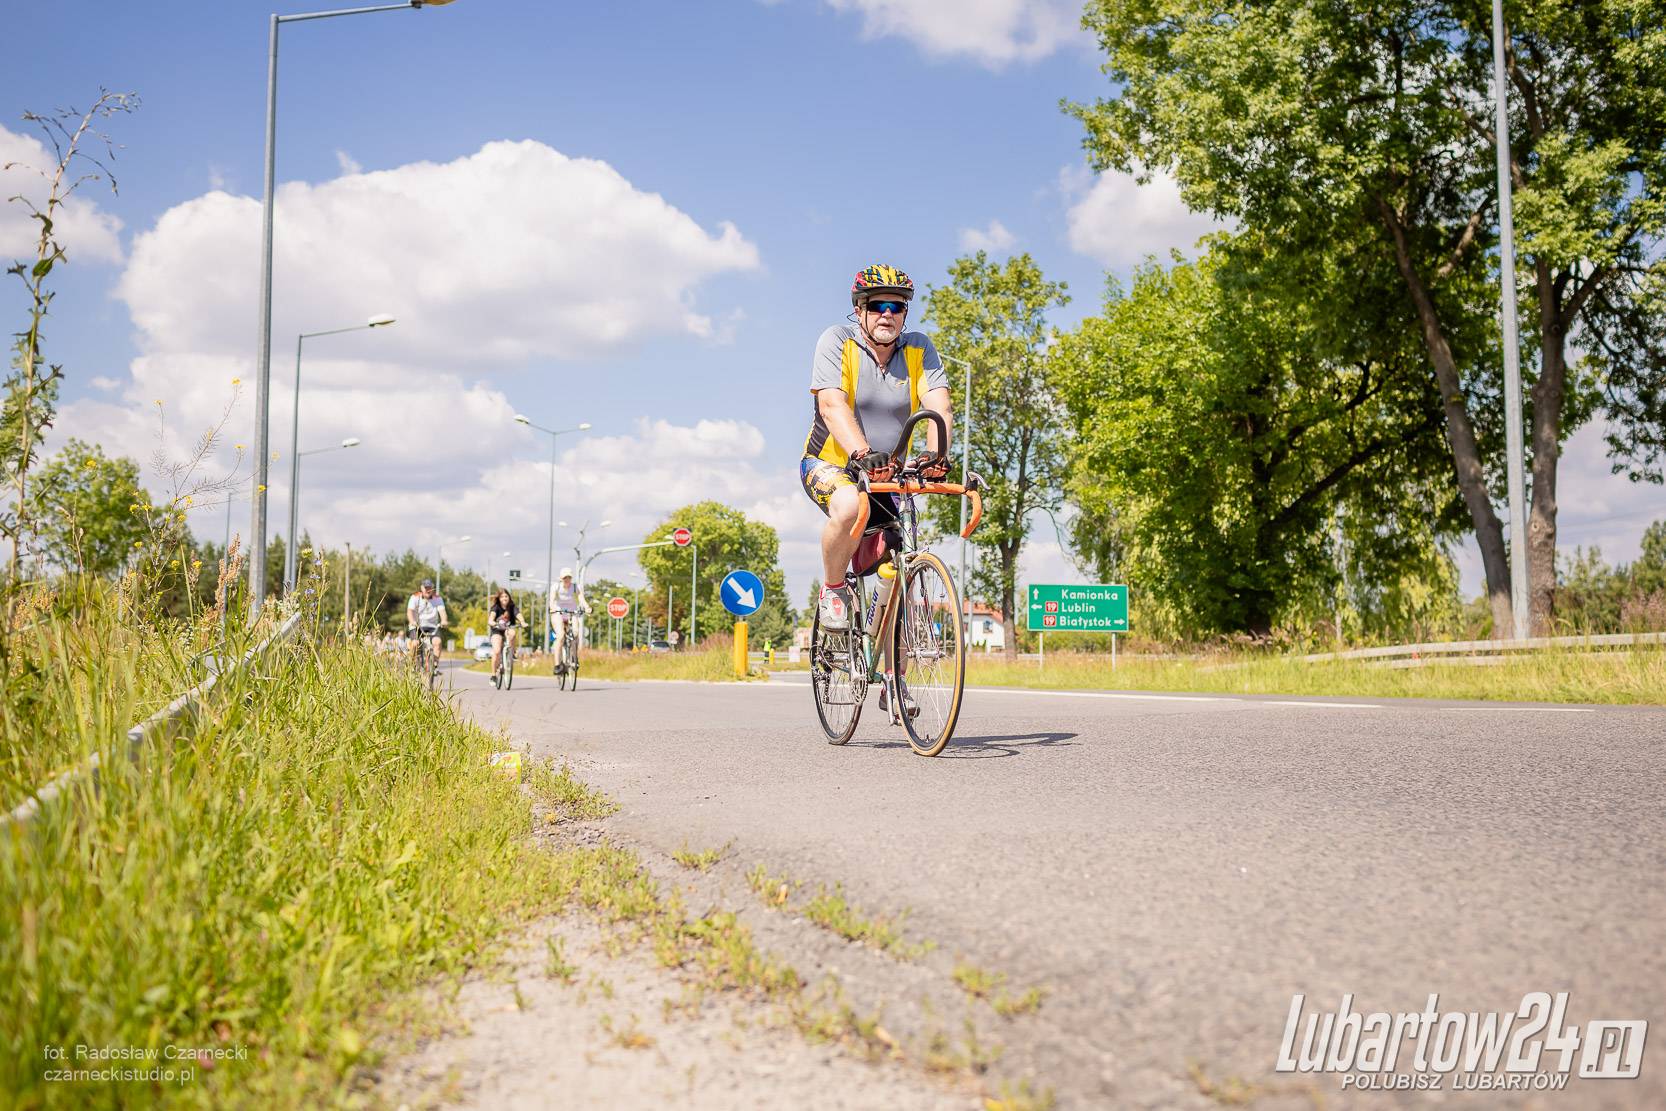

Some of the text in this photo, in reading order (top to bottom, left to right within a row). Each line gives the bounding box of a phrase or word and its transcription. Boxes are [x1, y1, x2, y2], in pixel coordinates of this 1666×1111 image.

[1061, 589, 1119, 600] Kamionka
[609, 604, 628, 612] STOP
[1047, 602, 1095, 612] 19 Lublin
[1045, 616, 1055, 625] 19
